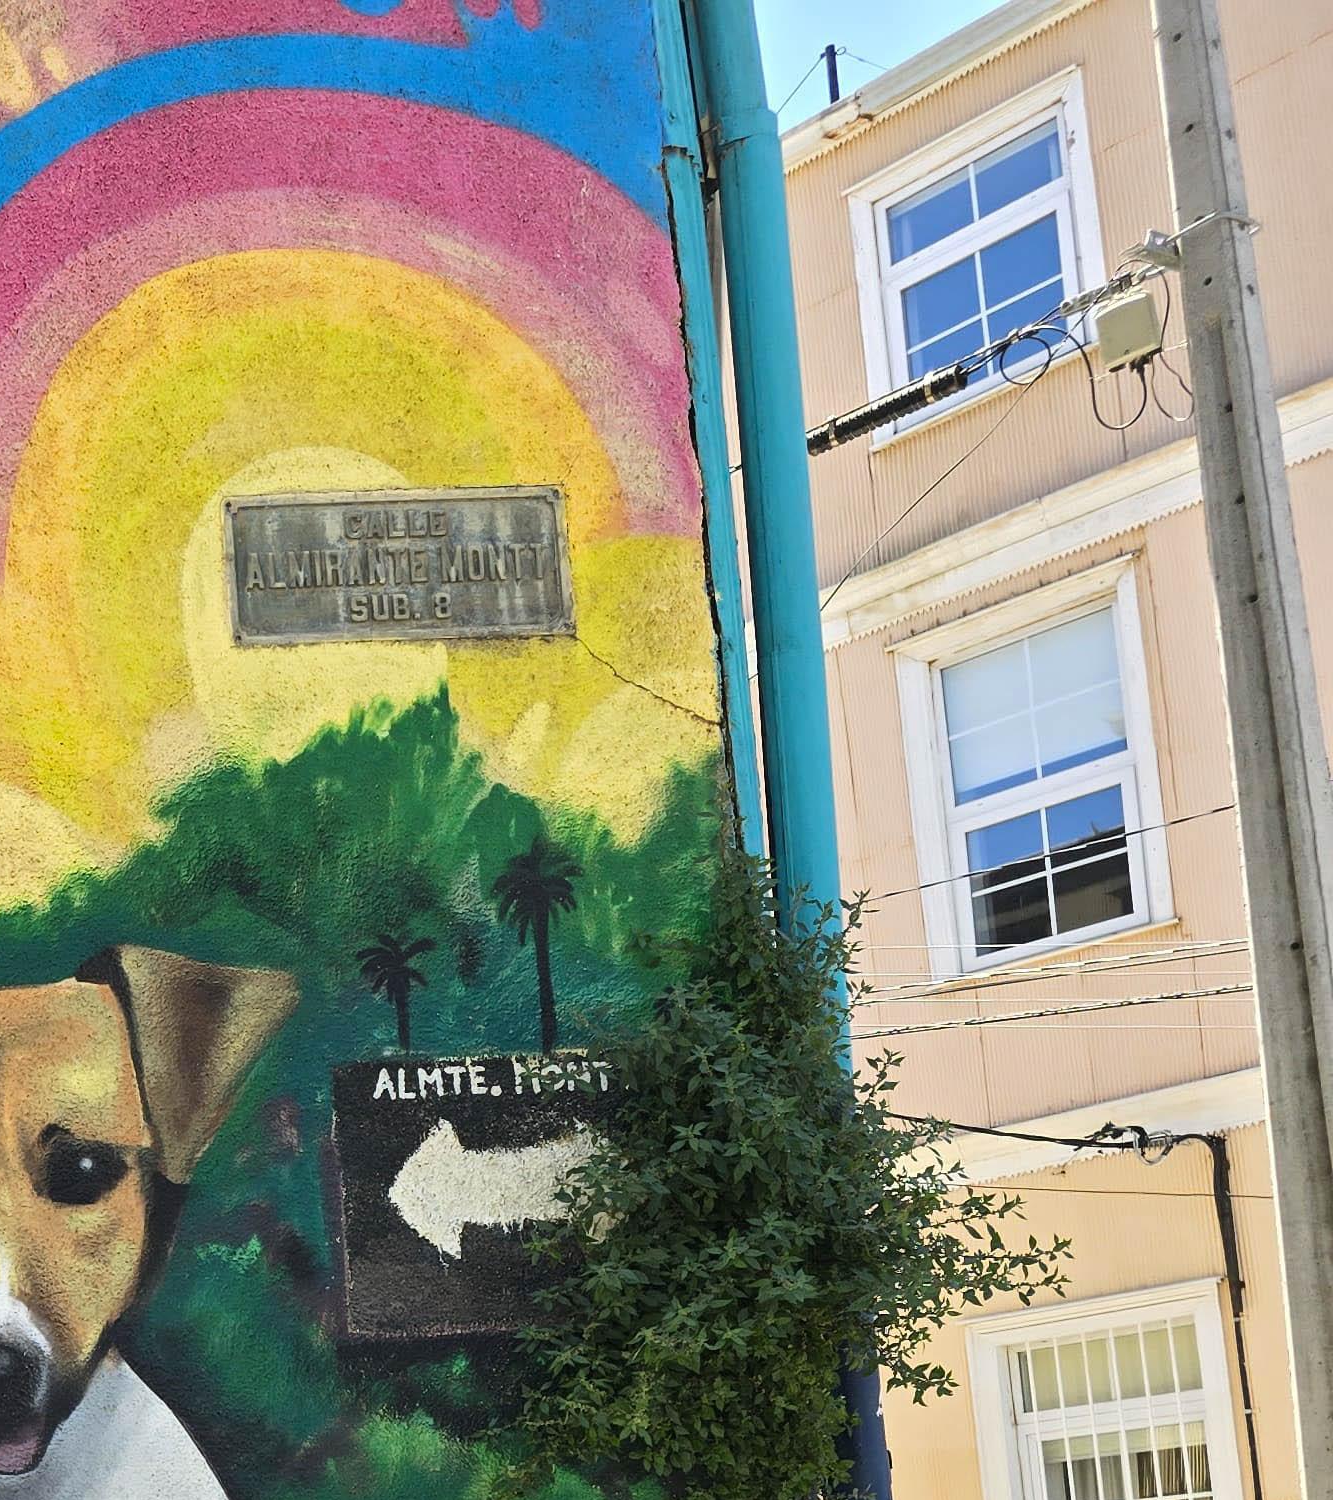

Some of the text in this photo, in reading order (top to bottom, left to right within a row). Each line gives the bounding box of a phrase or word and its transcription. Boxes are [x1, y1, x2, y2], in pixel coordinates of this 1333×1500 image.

[342, 509, 447, 540] CALLE
[245, 543, 550, 591] ALMIRANTE MONTT
[349, 591, 453, 622] SUB. 8
[372, 1059, 630, 1100] ALMTE. MONT
